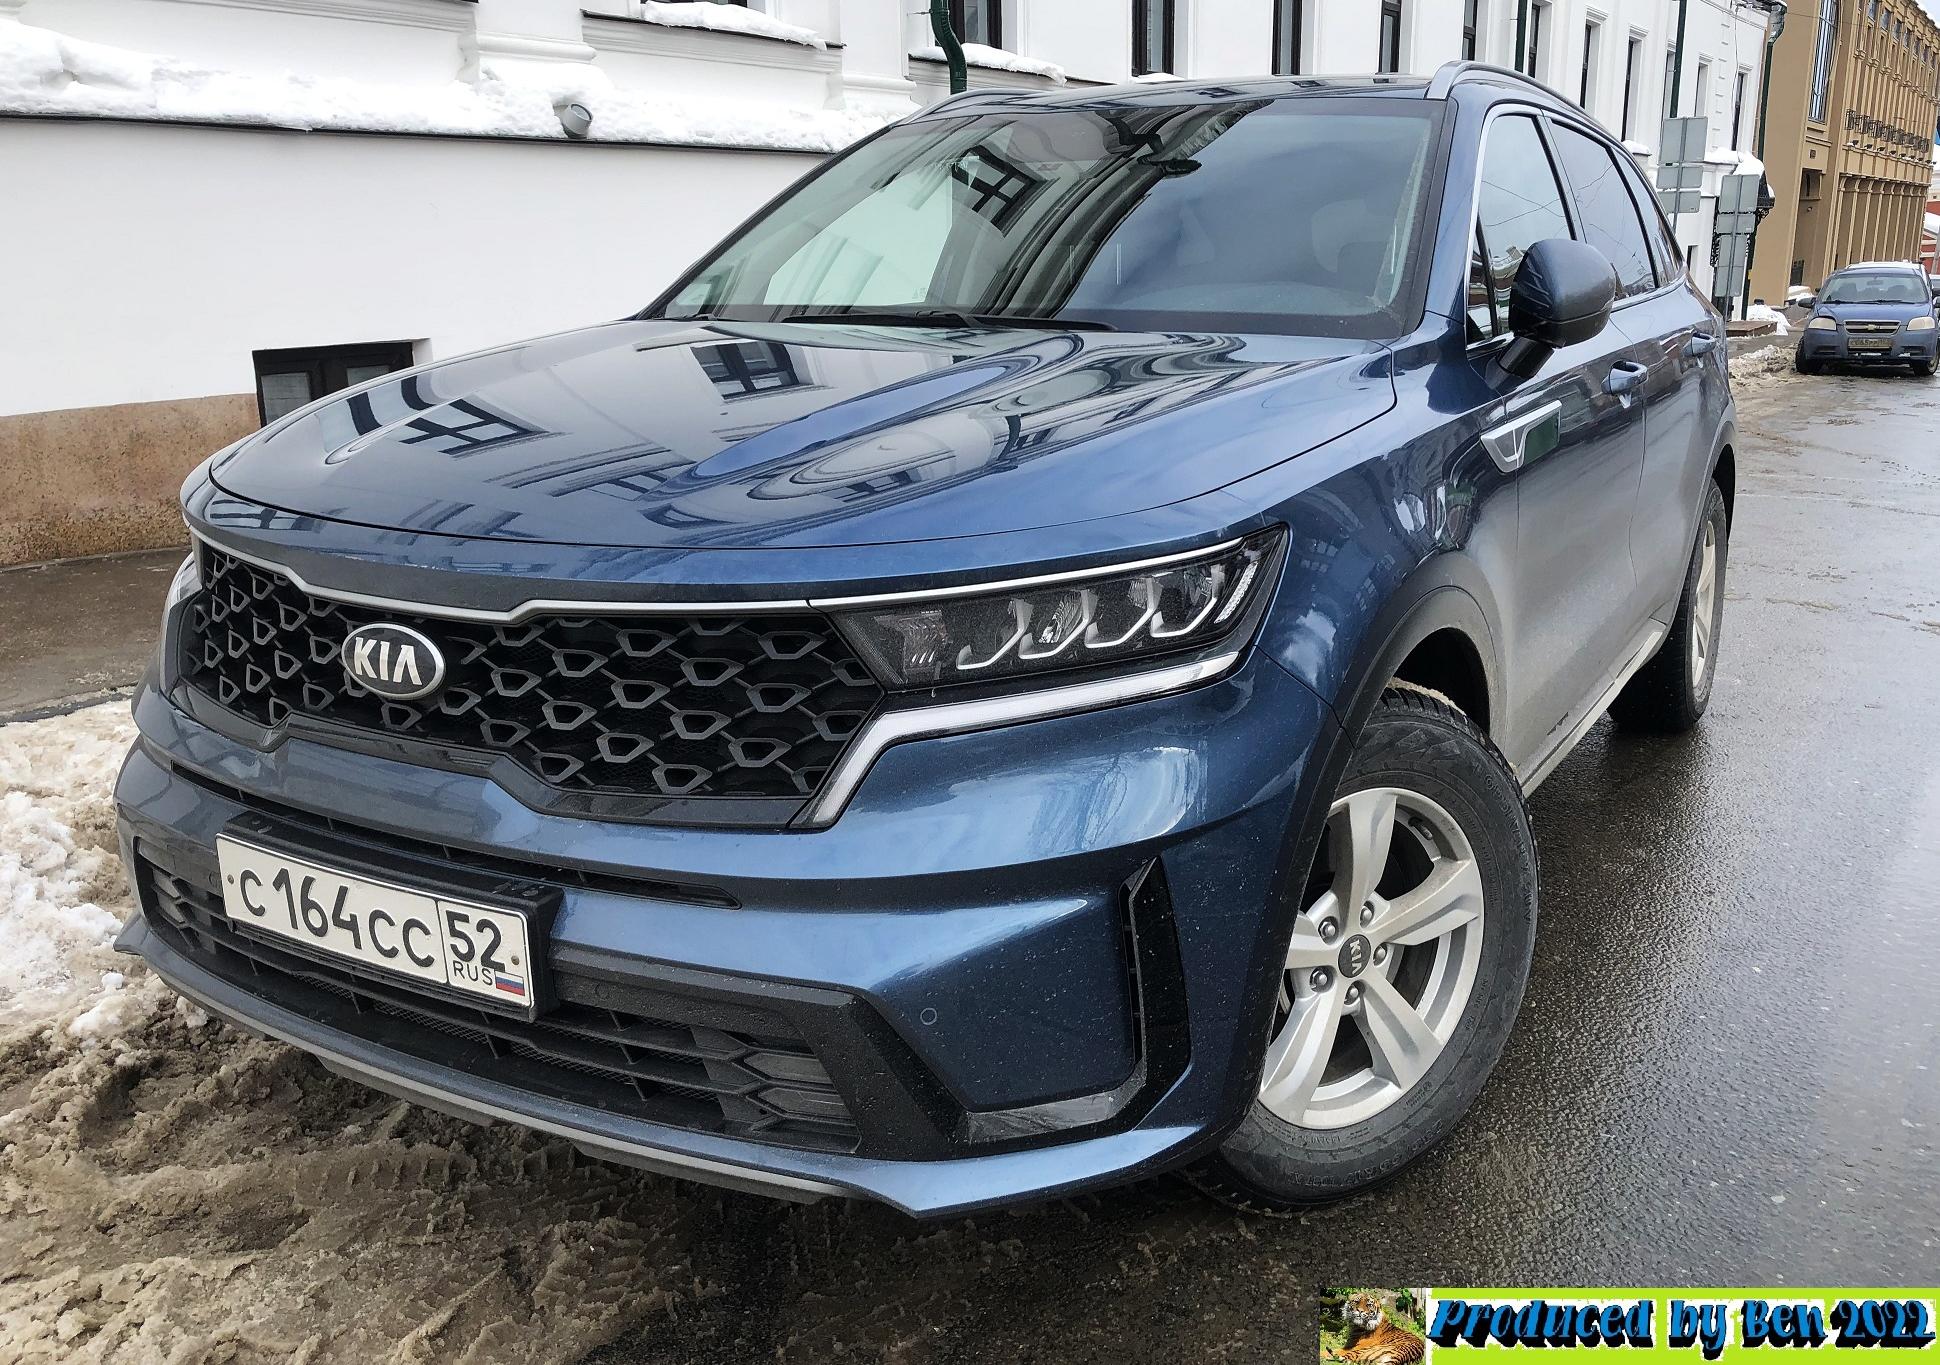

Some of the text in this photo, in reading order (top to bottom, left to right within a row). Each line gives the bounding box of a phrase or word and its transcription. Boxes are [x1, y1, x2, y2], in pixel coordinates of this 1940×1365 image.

[354, 637, 422, 685] KIA
[445, 910, 505, 973] 52
[1350, 939, 1362, 975] KIA
[453, 958, 493, 986] RUS
